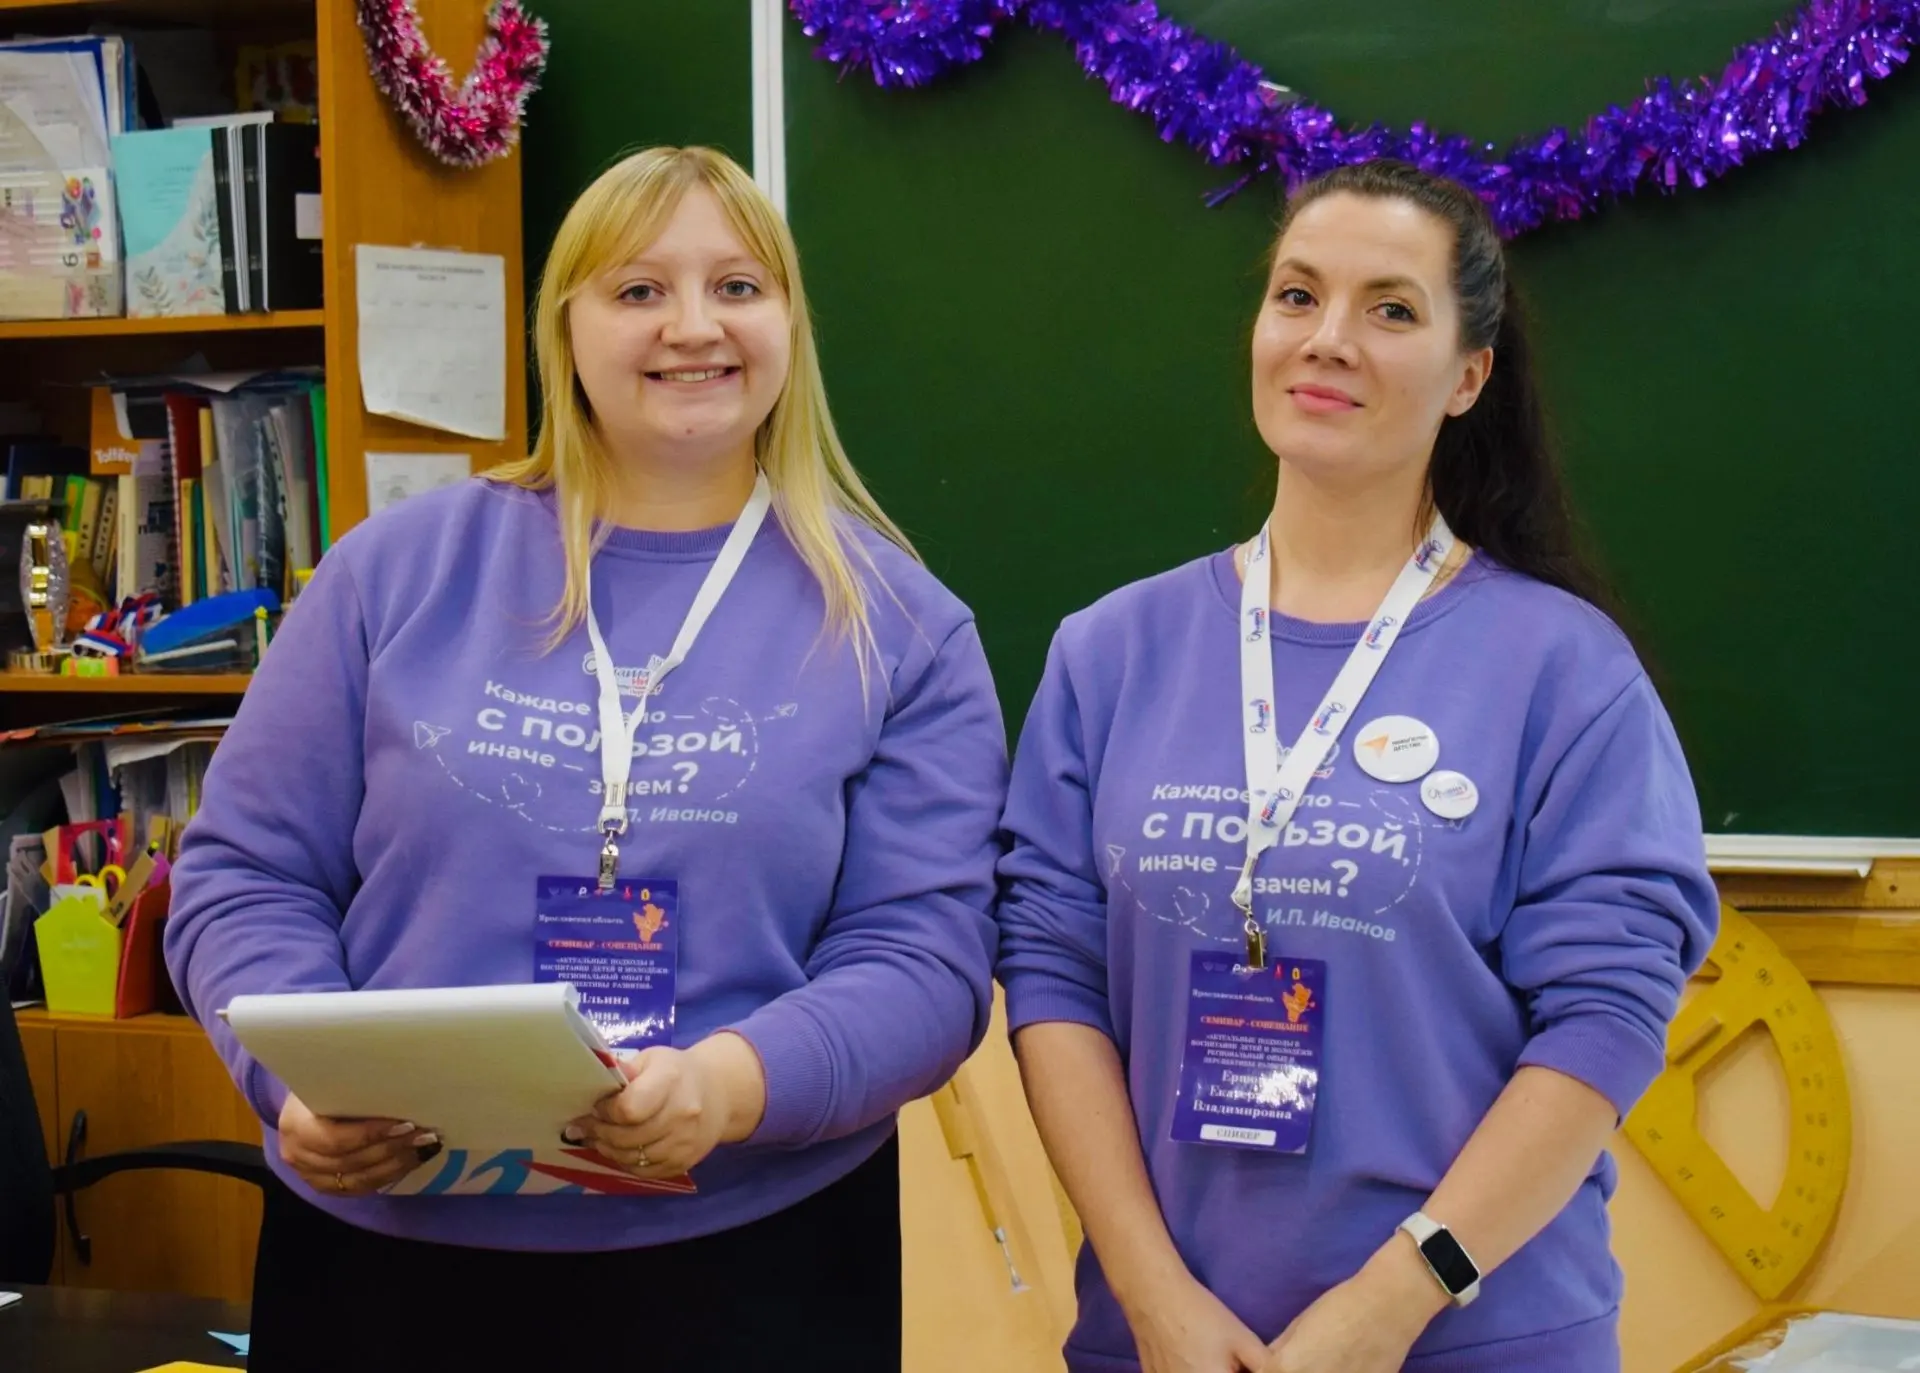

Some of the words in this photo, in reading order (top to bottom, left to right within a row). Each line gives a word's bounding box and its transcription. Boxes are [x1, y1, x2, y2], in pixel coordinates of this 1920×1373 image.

[484, 680, 591, 716] Каждое
[467, 739, 555, 768] иначе
[588, 760, 699, 796] зем?
[1152, 783, 1250, 806] Каждое
[650, 806, 738, 824] Иванов
[1181, 812, 1410, 867] поьзой,
[1139, 853, 1218, 873] иначе
[1252, 858, 1359, 898] зачем?
[1266, 908, 1306, 926] И.П.
[1312, 912, 1396, 943] Иванов
[1200, 1015, 1246, 1027] СЕМИНАР
[1192, 1099, 1293, 1121] Владимировна
[1216, 1129, 1261, 1141] СПИКЕР
